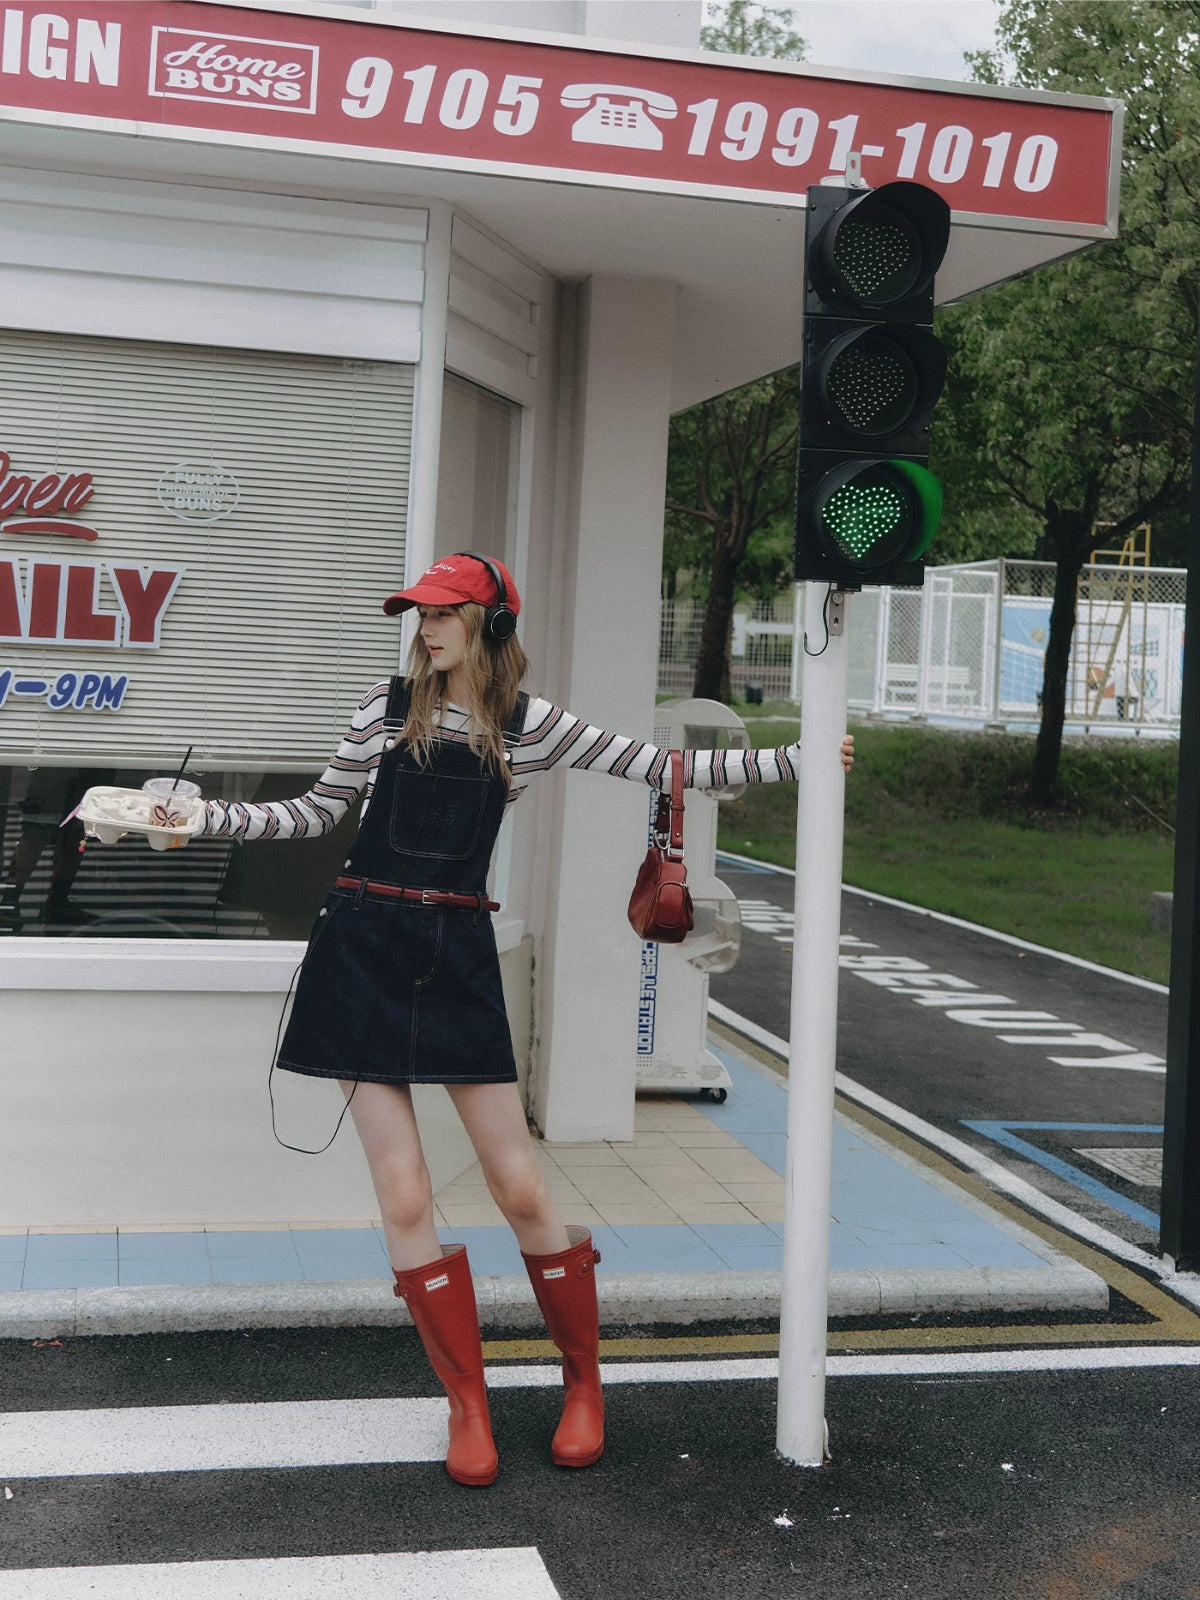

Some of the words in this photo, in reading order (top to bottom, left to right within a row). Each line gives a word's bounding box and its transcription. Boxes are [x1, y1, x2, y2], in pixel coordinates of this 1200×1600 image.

[2, 9, 121, 86] IGN
[164, 42, 306, 79] Home
[165, 68, 302, 101] BUNS
[341, 56, 543, 136] 9105
[687, 98, 1058, 193] 1991-1010
[0, 449, 95, 518] pen
[174, 496, 223, 511] BUNS
[838, 955, 1167, 1073] BEAUTY
